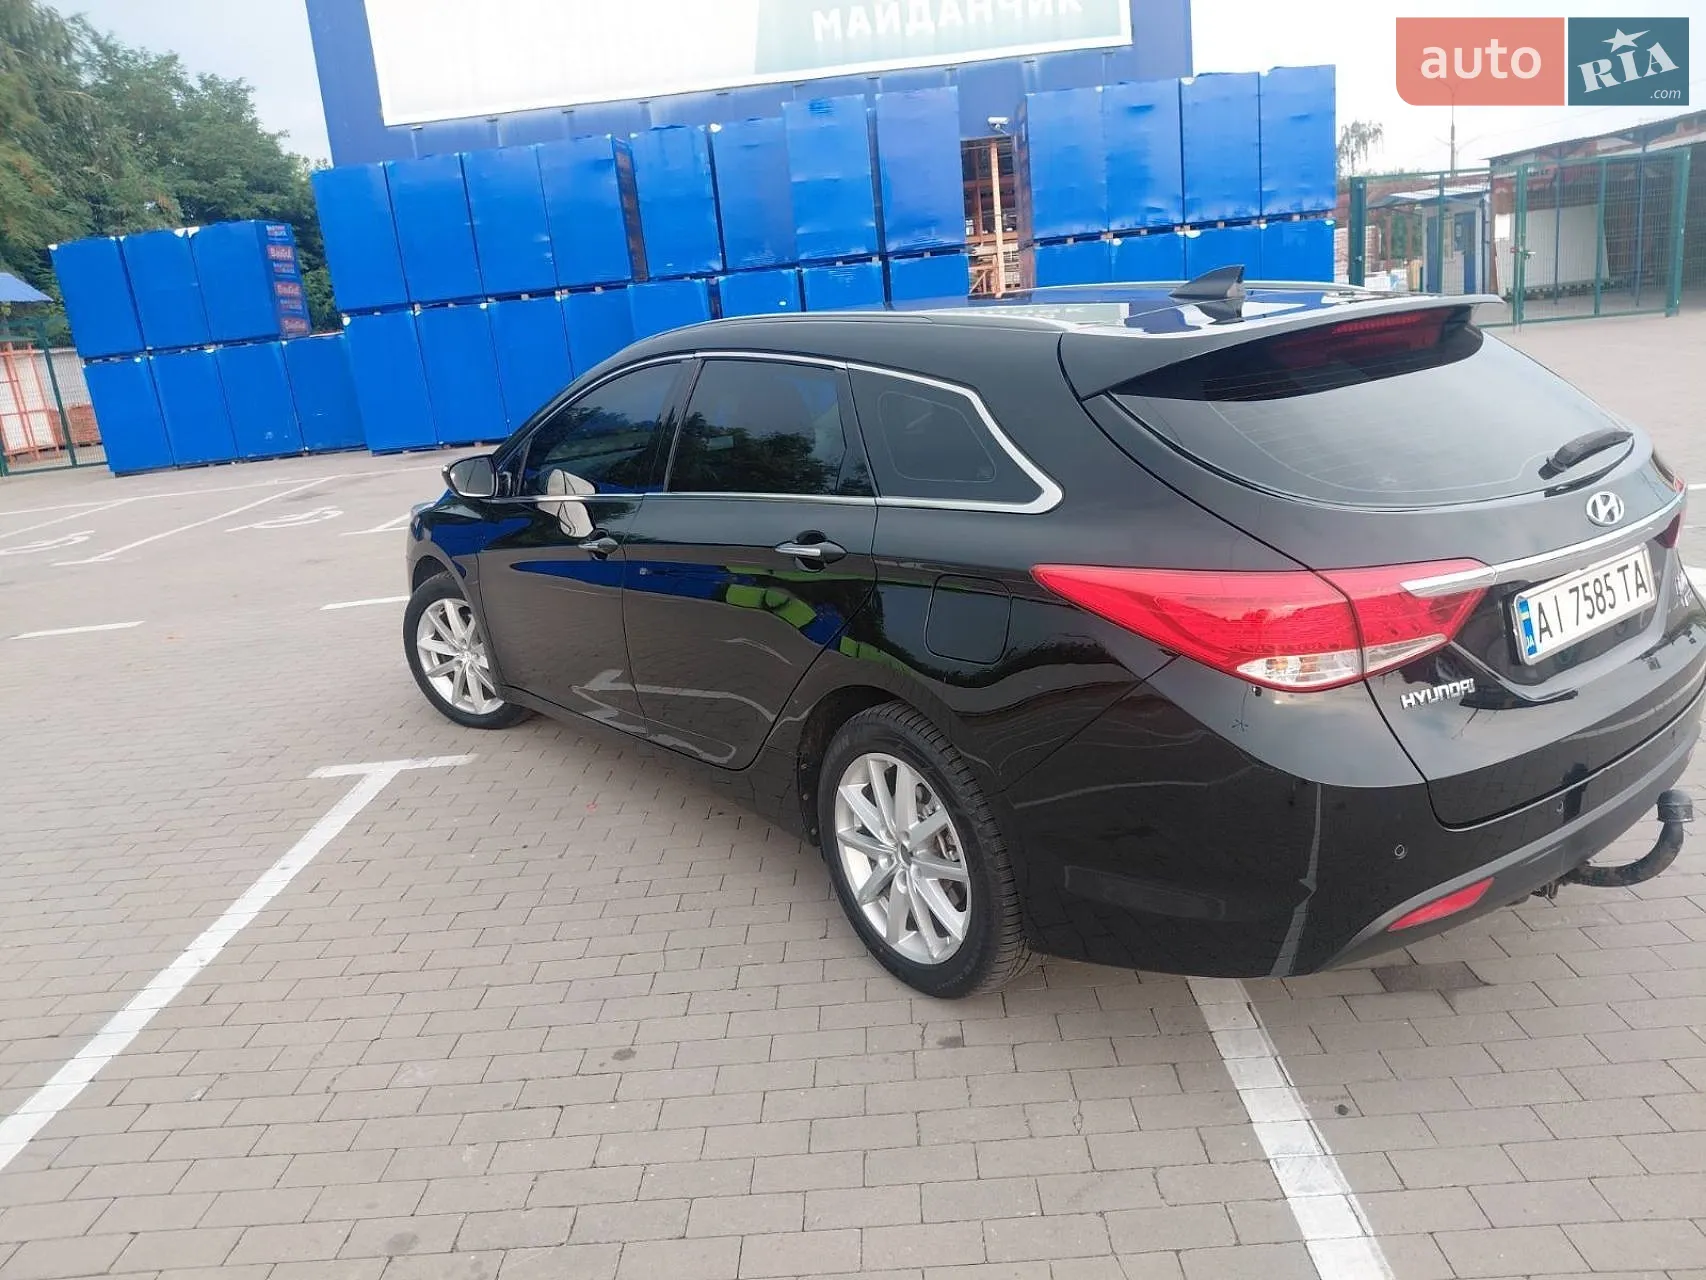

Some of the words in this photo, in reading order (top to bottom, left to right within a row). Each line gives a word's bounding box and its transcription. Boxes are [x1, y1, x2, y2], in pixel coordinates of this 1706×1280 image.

[1538, 594, 1563, 643] AI
[1568, 572, 1616, 626] 7585
[1617, 559, 1648, 602] TA
[1400, 678, 1476, 709] HYUNDAI
